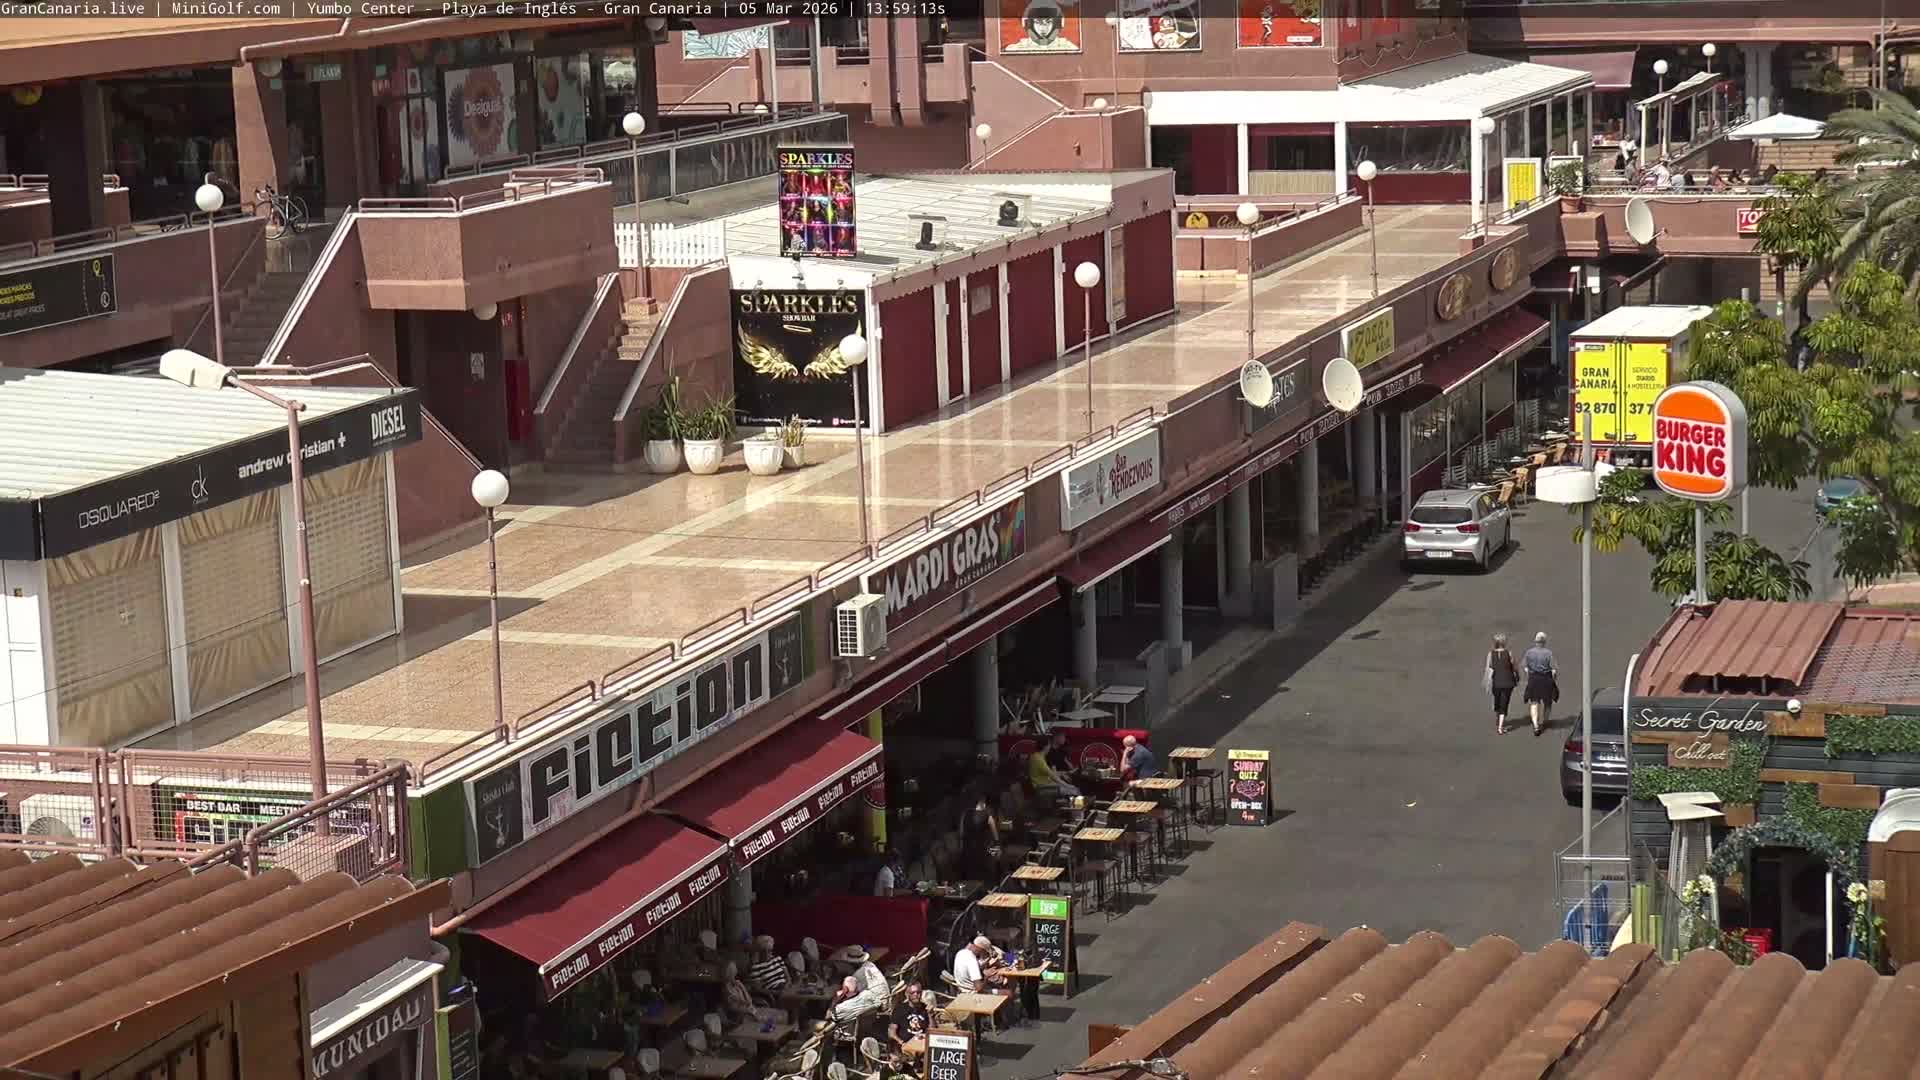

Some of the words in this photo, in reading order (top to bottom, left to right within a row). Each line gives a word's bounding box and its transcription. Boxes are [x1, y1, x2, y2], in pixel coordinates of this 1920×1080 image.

[780, 153, 853, 165] SPARKLES
[740, 293, 859, 315] SPARKLES
[1582, 368, 1610, 378] GRAN
[1575, 379, 1618, 389] CANARIA
[371, 404, 406, 441] DIESEL
[1656, 418, 1726, 448] BURGER
[238, 452, 285, 479] andrew
[286, 437, 336, 464] cristian
[1656, 439, 1727, 478] KING
[884, 542, 950, 617] MARDI
[953, 511, 1000, 576] GRAS
[1634, 707, 1692, 728] Secret
[1697, 696, 1768, 739] Garden
[1233, 760, 1264, 773] SUNDAY
[1239, 771, 1258, 781] QUIZ
[186, 800, 214, 811] BEST
[216, 801, 241, 813] BAR
[259, 804, 301, 817] MEETIN
[1035, 923, 1061, 936] LARGE
[1036, 934, 1058, 945] BEER
[931, 1047, 966, 1066] LARGE
[931, 1064, 957, 1080] BEER
